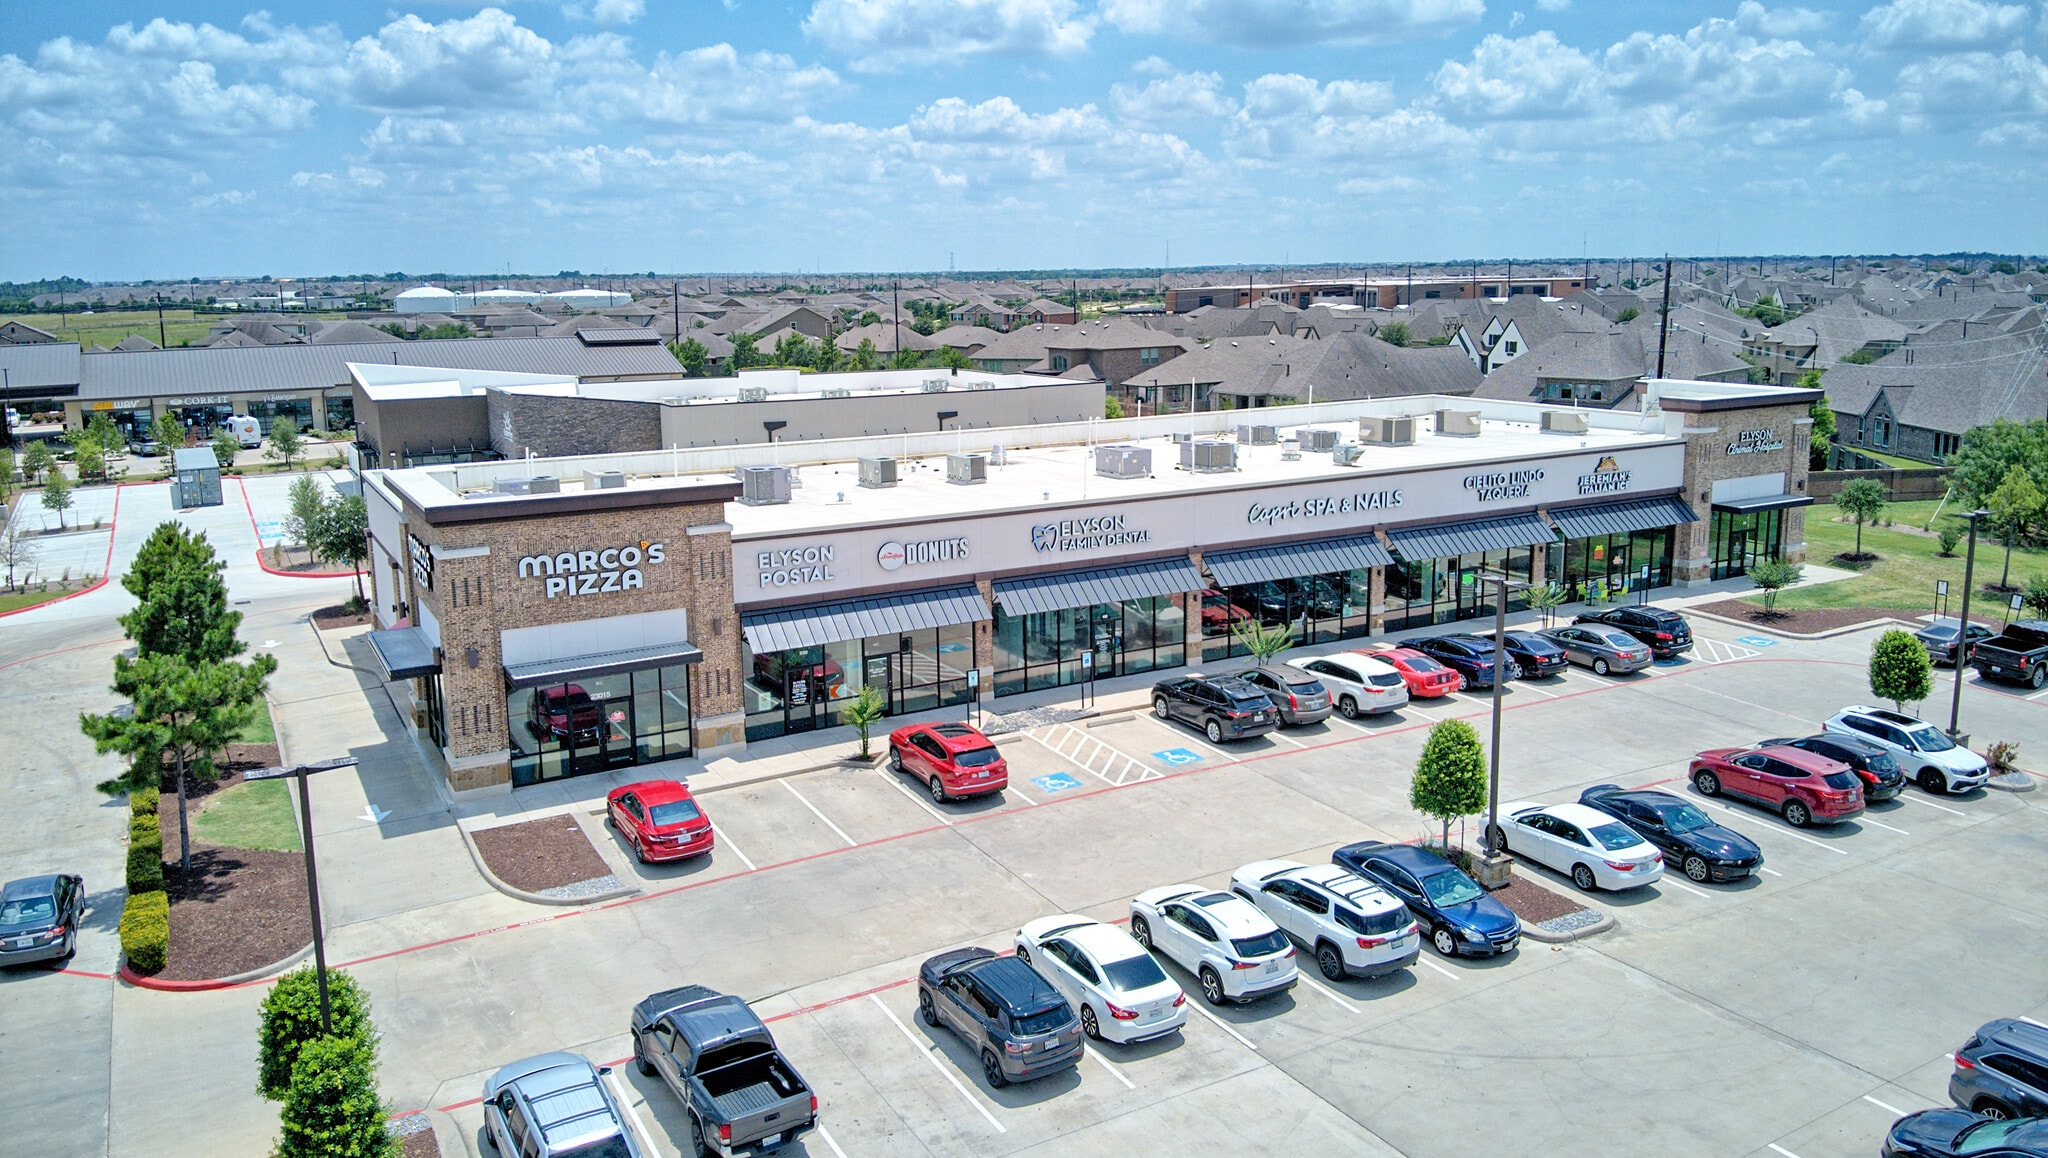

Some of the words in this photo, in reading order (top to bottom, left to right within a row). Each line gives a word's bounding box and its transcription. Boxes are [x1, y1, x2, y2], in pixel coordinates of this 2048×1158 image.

[93, 399, 139, 411] SUBWAY
[183, 396, 229, 405] CORK-IT
[1739, 429, 1773, 442] ELYSON
[1464, 473, 1506, 489] CIELITO
[1509, 469, 1545, 485] LINDO
[1577, 470, 1633, 486] JEREMIAH'S
[1579, 482, 1616, 494] ITALIAN
[1615, 480, 1631, 490] ICE
[1248, 501, 1300, 525] Capri
[1304, 498, 1337, 517] SPA
[1340, 498, 1351, 513] &
[1354, 490, 1404, 511] NAILS
[1060, 515, 1126, 537] ELYSON
[905, 537, 970, 565] DONUTS
[1060, 535, 1104, 551] FAMILY
[1106, 530, 1151, 546] DENTAL
[518, 540, 666, 579] MARCO'S
[758, 546, 834, 569] ELYSON
[546, 568, 643, 598] PIZZA
[760, 565, 834, 588] POSTAL
